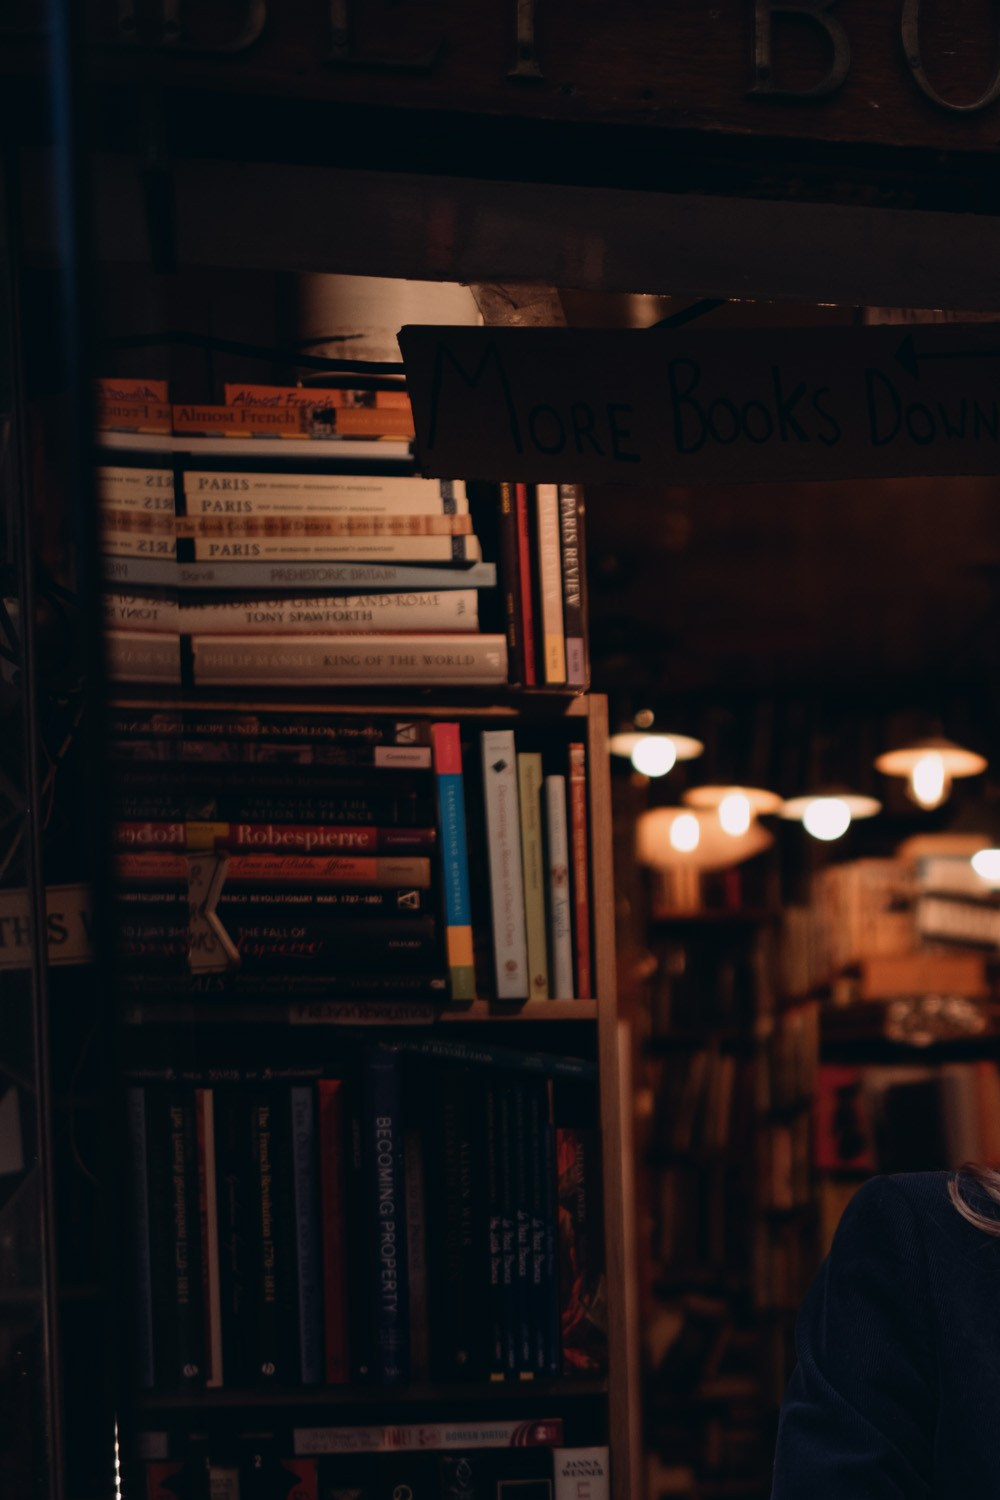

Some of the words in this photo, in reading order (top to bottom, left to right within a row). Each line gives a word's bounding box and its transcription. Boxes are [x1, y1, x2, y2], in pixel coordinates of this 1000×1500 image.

[180, 408, 234, 424] Almost
[240, 410, 296, 425] French
[427, 341, 641, 462] MORE
[667, 358, 845, 454] BOOKS
[199, 478, 251, 491] PARIS
[201, 500, 253, 514] PARIS
[562, 497, 579, 543] PARIS
[209, 543, 261, 557] PARIS
[564, 546, 580, 608] REVIEW
[246, 611, 284, 624] TONY
[290, 609, 372, 622] SPAWFORTH
[324, 655, 362, 667] KING
[368, 655, 385, 667] OF
[390, 655, 418, 666] THE
[424, 654, 475, 666] WORLD
[229, 723, 270, 737] UNDER
[275, 725, 337, 738] NAPOLEON
[237, 824, 370, 851] Robespierre
[447, 783, 459, 856] TRANSLATING
[450, 861, 463, 918] MONTREAL
[238, 927, 259, 938] THE
[263, 927, 285, 939] FALL
[291, 927, 308, 938] OF
[259, 1105, 269, 1128] The
[260, 1132, 272, 1172] French
[376, 1116, 395, 1216] BECOMING
[460, 1139, 471, 1199] ALISON
[262, 1174, 274, 1237] Revolution
[462, 1206, 473, 1246] WEIR
[380, 1221, 398, 1313] PROPERTY
